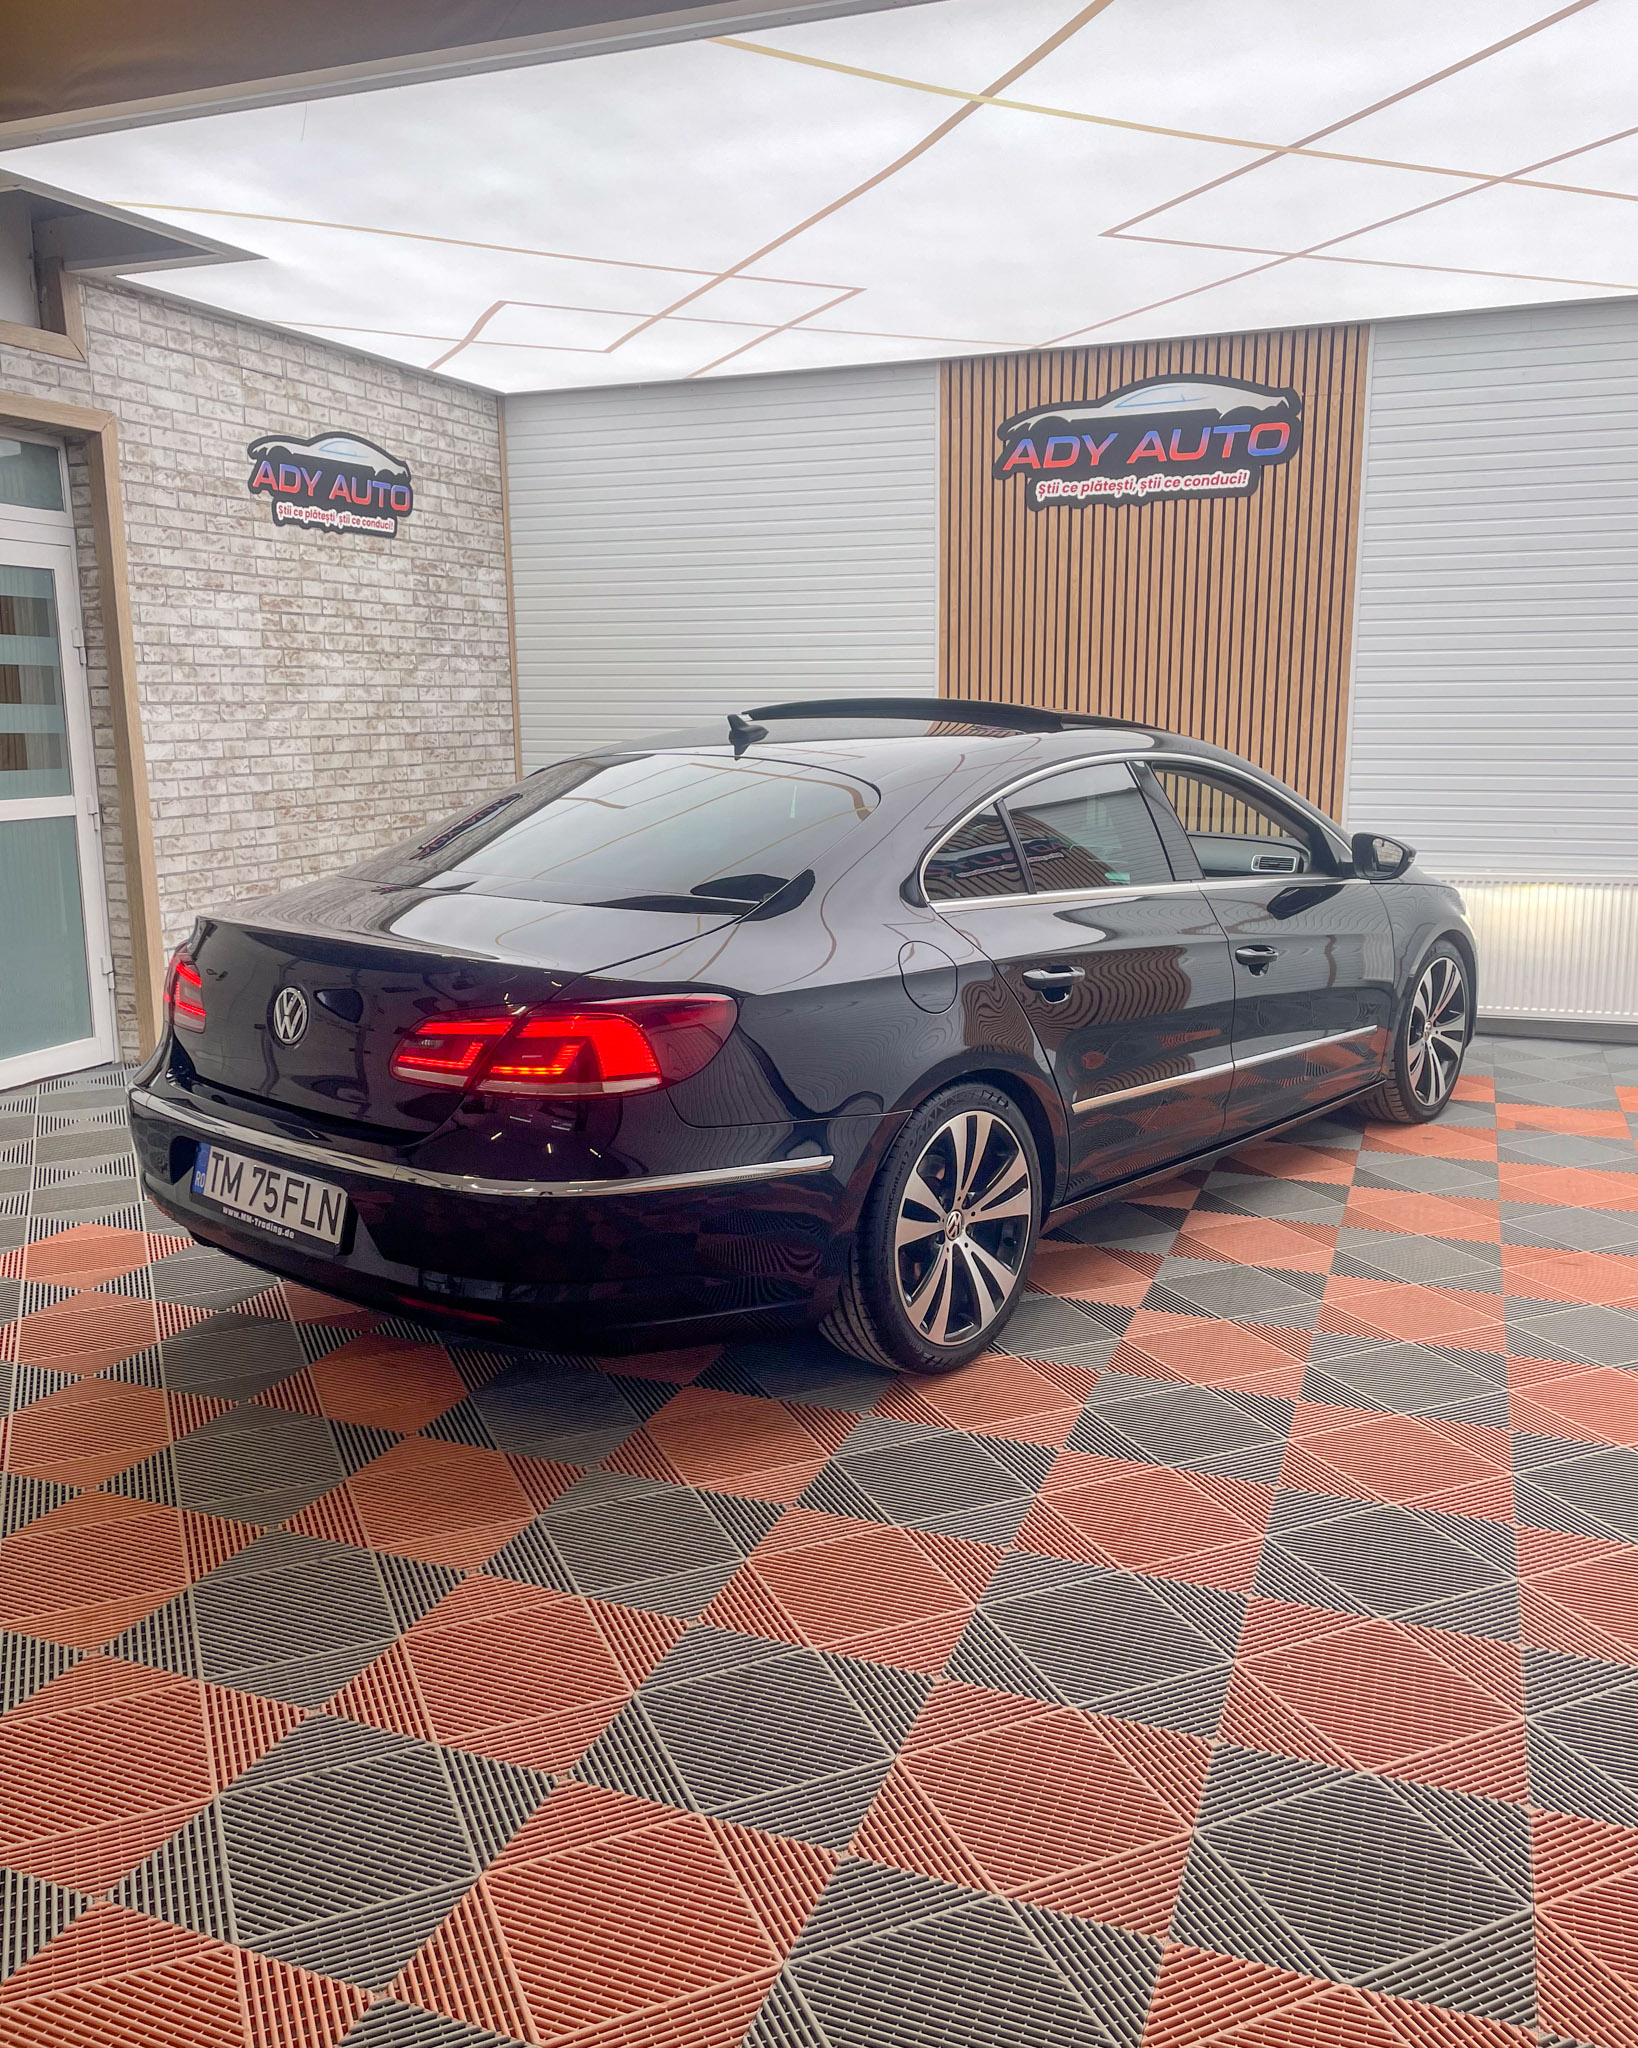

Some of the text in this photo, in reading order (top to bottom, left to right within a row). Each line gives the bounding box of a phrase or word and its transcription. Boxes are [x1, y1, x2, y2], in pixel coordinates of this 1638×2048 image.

[1002, 422, 1291, 471] ADY AUTO
[252, 460, 410, 512] ADY AUTO
[1038, 472, 1248, 499] Știi ce plătești, știi ce conduci!
[294, 507, 303, 517] ce
[352, 516, 361, 526] ce
[362, 517, 394, 531] conduci!
[194, 1170, 206, 1188] RO
[211, 1151, 244, 1202] TM
[222, 1206, 295, 1239] www.MM-Trading.de
